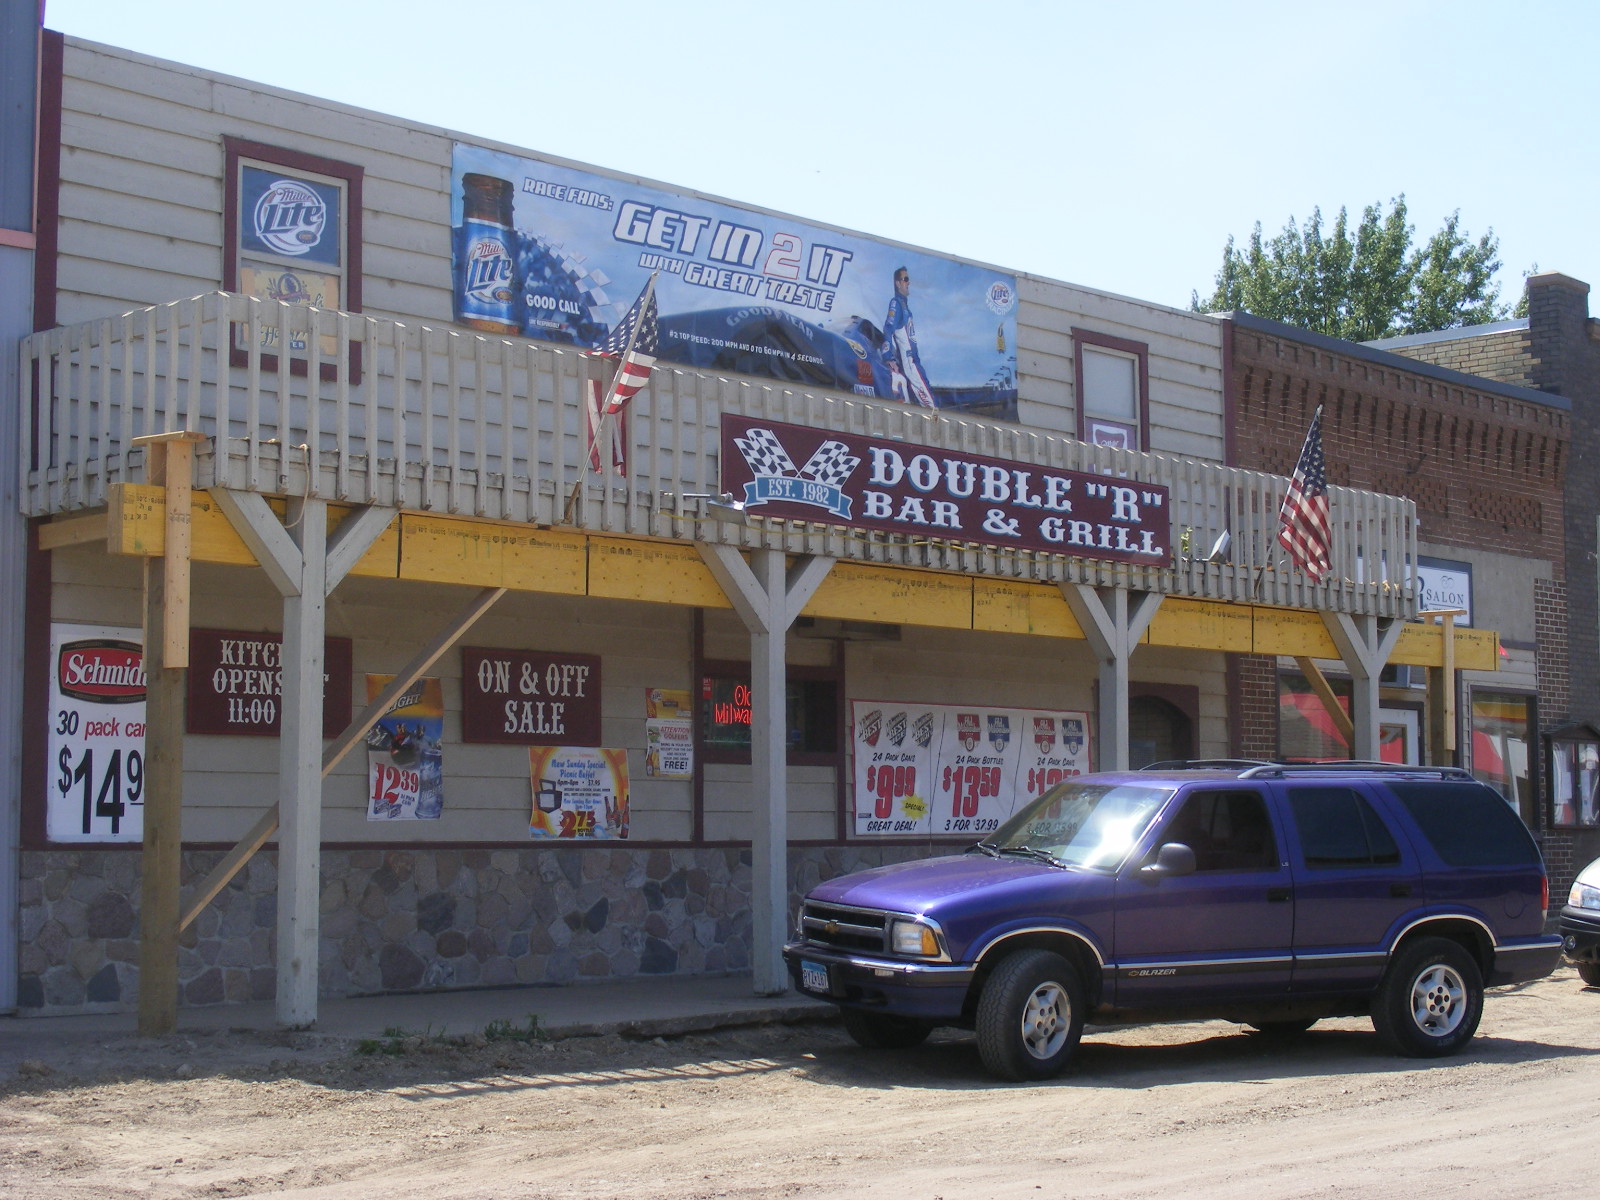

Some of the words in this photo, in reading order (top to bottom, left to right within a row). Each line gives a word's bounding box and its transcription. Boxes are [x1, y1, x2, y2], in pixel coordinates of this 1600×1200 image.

[522, 177, 567, 201] RACE
[566, 187, 613, 211] FANS:
[260, 203, 322, 234] Lite
[613, 200, 711, 256] GET
[707, 220, 764, 269] IN
[763, 232, 802, 280] 2
[806, 243, 853, 288] IT
[638, 252, 684, 275] WITH
[683, 262, 764, 294] GREAT
[765, 279, 835, 312] TASTE
[525, 294, 556, 310] GOOD
[559, 299, 581, 315] CALL
[679, 332, 690, 341] TOP
[711, 339, 724, 347] 200
[725, 341, 738, 349] MPH
[739, 343, 750, 352] AND
[755, 346, 763, 354] TO
[763, 346, 772, 355] 60
[790, 352, 796, 361] 4
[768, 478, 796, 498] EST.
[802, 483, 830, 505] 1982
[869, 446, 1072, 513] DOUBLE
[1085, 481, 1163, 523] "R"
[862, 489, 963, 530] BAR
[981, 508, 1022, 537] &
[1038, 517, 1164, 557] GRILL
[1426, 588, 1464, 605] SALON
[220, 639, 283, 667] KITC
[478, 659, 512, 693] ON
[519, 662, 540, 695] &
[545, 663, 589, 698] OFF
[228, 698, 276, 725] 11:00
[504, 700, 565, 735] SALE
[56, 710, 80, 736] 30
[84, 717, 121, 740] pack
[863, 719, 882, 740] BEST
[566, 759, 586, 769] Sunday
[587, 760, 606, 769] Special
[664, 760, 688, 770] FREE!
[872, 752, 882, 762] 24
[955, 755, 966, 764] 24
[1037, 757, 1046, 766] 24
[560, 769, 578, 778] Picnic
[905, 802, 925, 812] SPECIAL!
[867, 820, 893, 832] GREAT
[894, 820, 917, 832] DEAL!
[944, 820, 951, 831] 3
[953, 820, 970, 832] FOR
[1139, 968, 1176, 977] BLAZER
